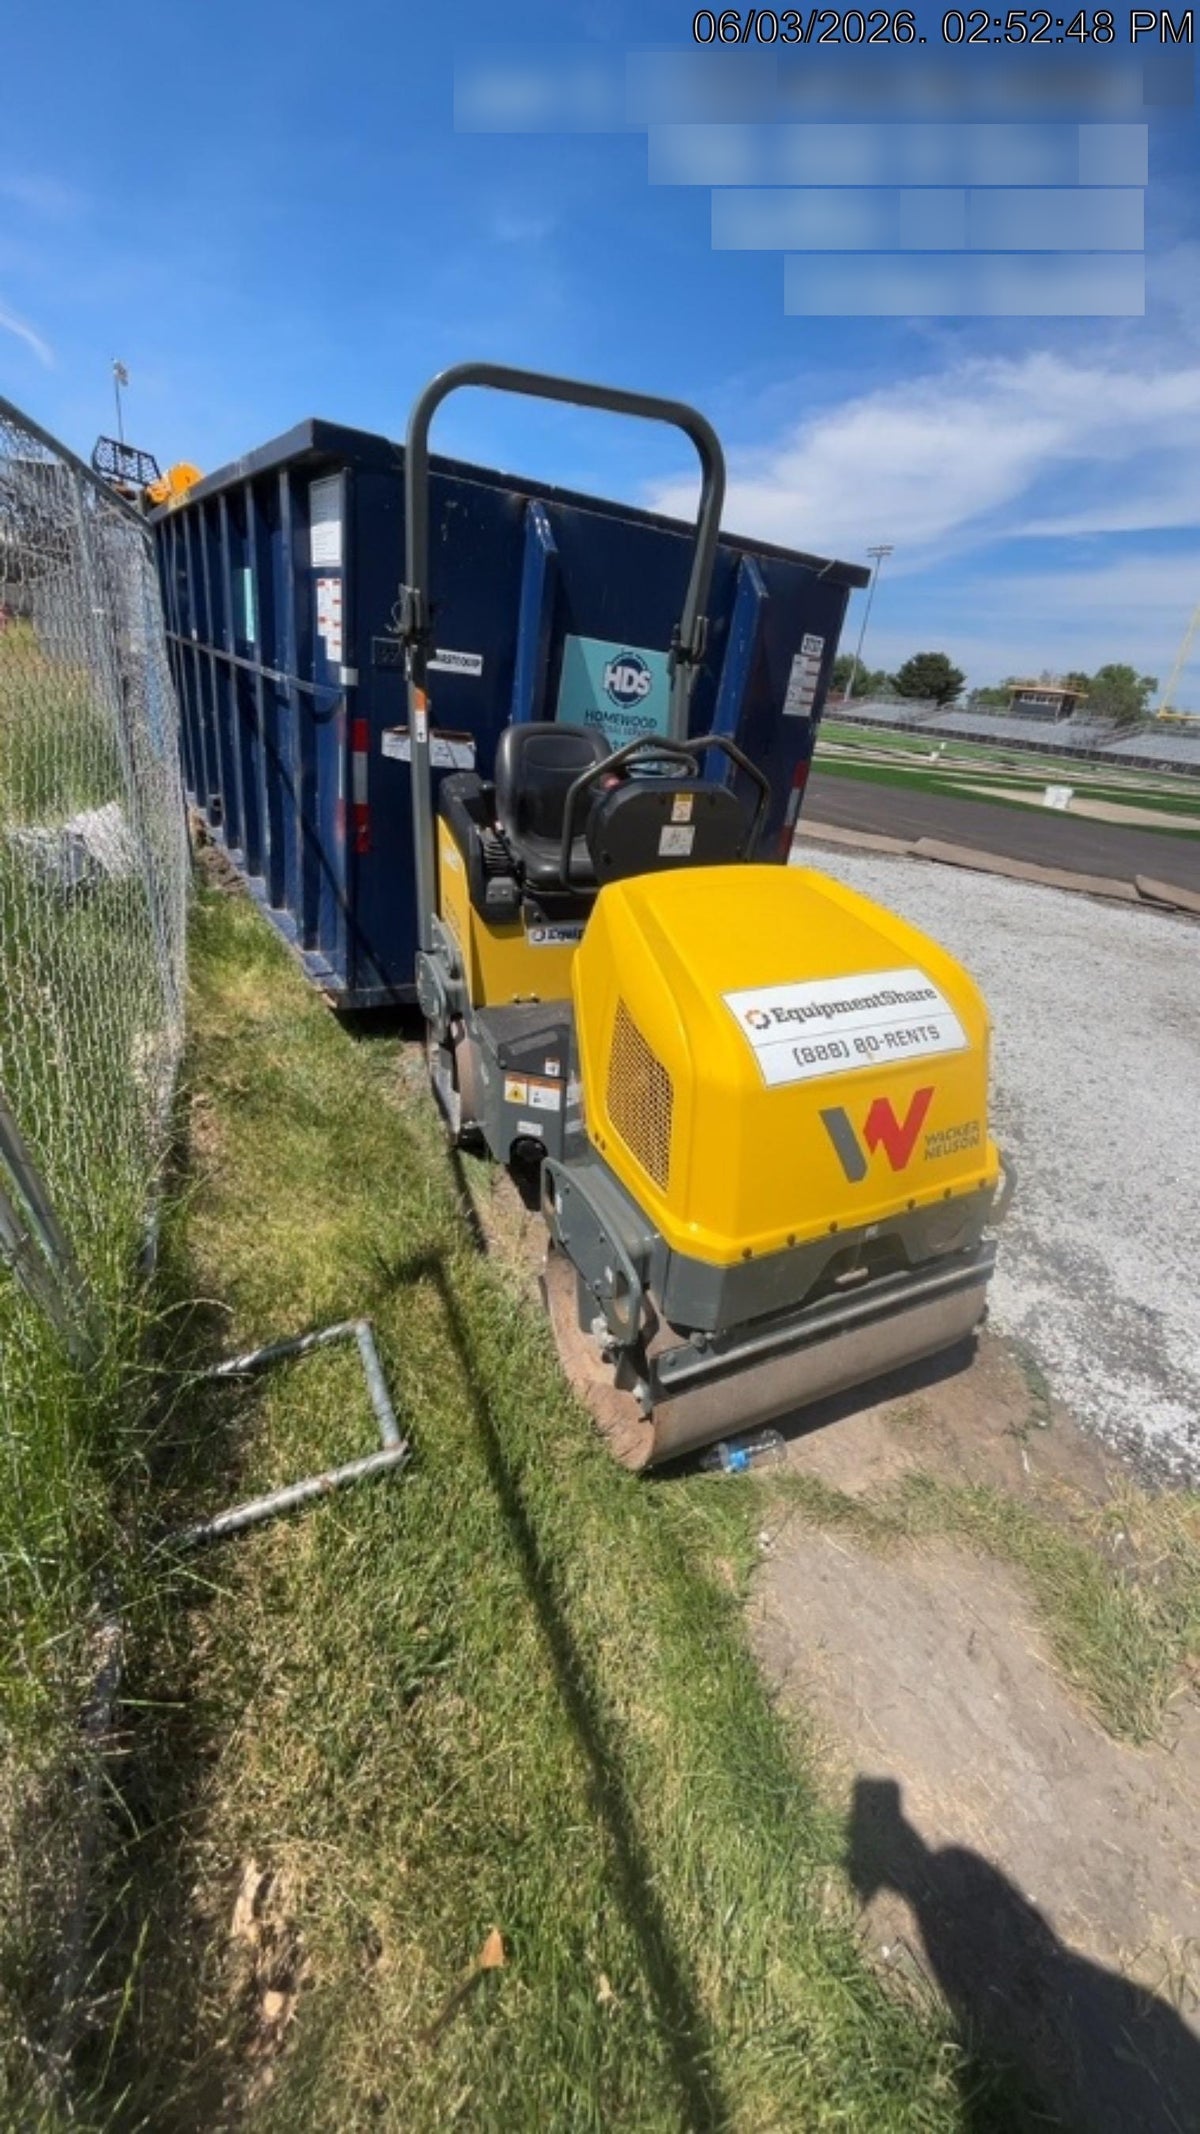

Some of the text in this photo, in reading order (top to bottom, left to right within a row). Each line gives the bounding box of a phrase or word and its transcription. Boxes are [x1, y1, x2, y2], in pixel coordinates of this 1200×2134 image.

[603, 664, 652, 695] HDS
[584, 709, 658, 729] HOMEWOOD
[771, 987, 937, 1024] EquipmentShare
[792, 1025, 941, 1067] (888) 80-RENTS
